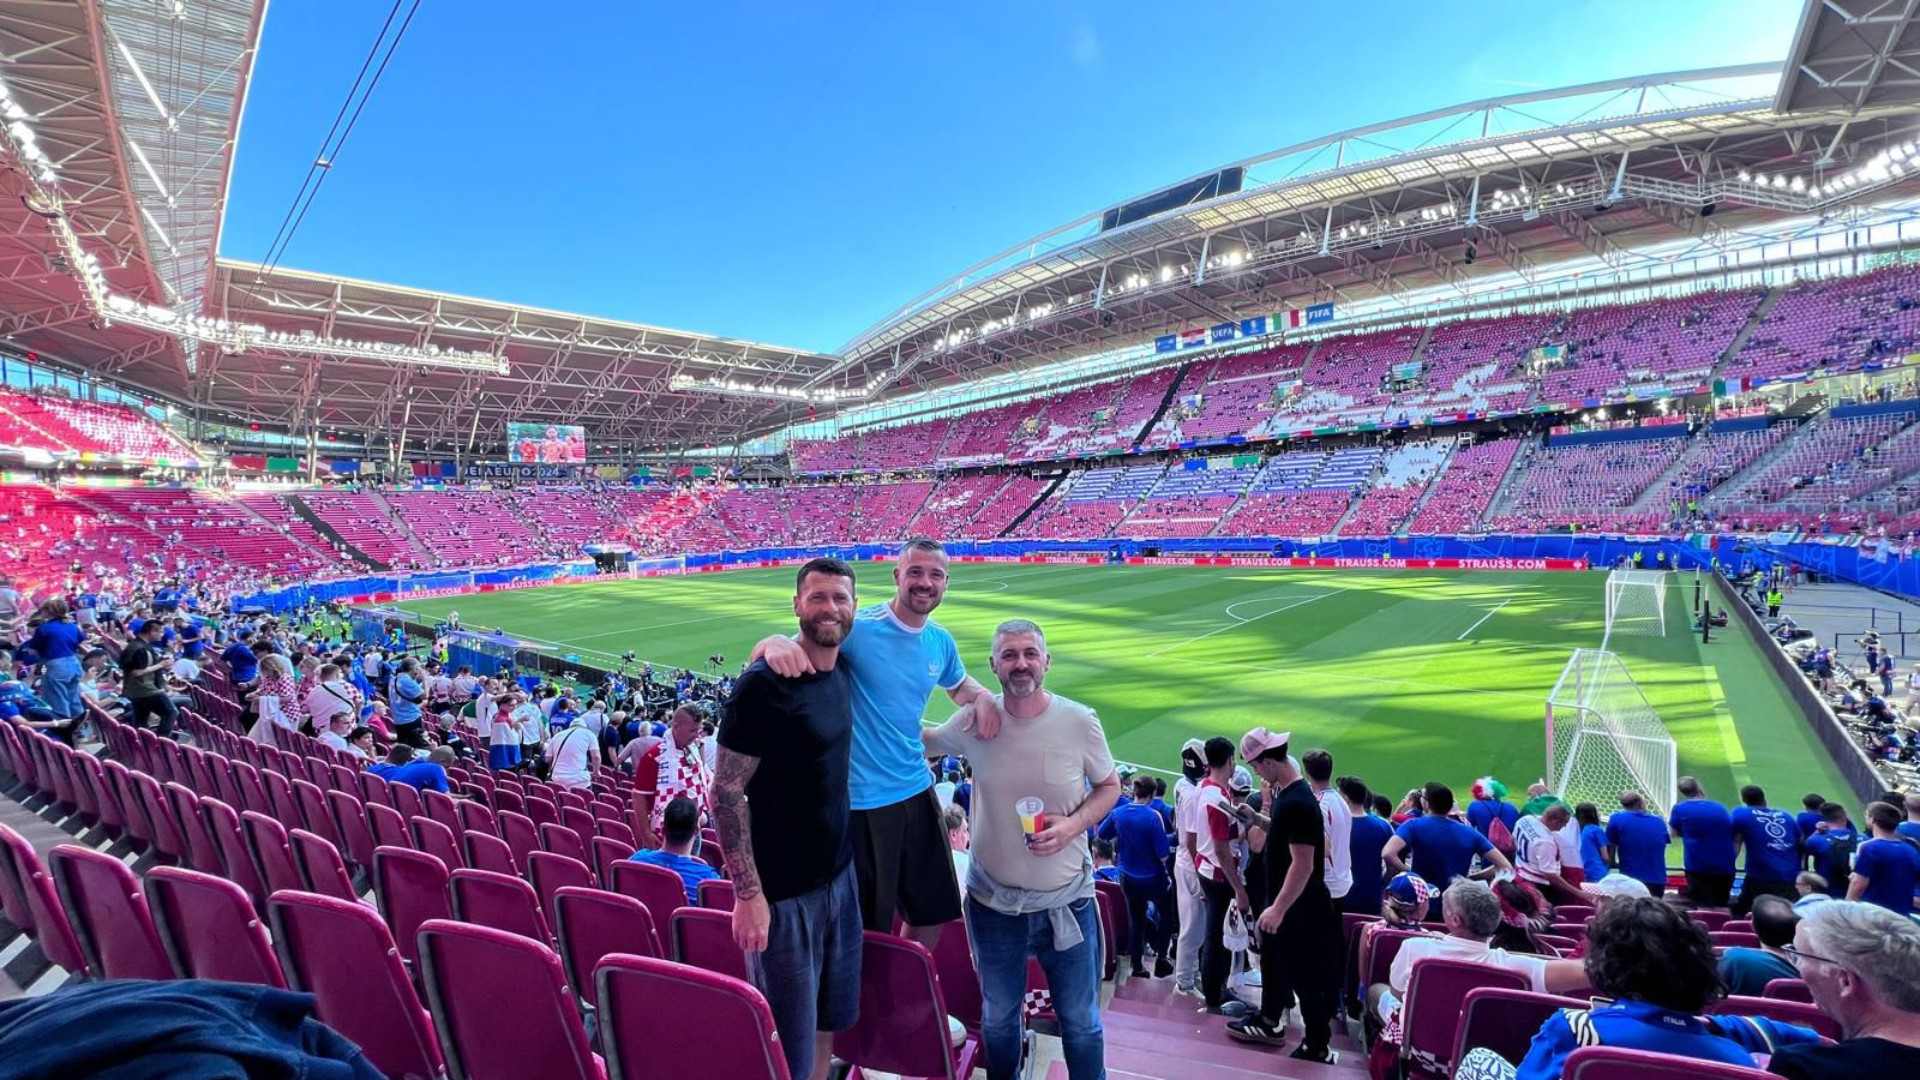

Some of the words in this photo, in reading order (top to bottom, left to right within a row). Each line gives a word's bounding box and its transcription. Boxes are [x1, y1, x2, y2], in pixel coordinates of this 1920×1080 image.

[1309, 308, 1330, 319] FIFA
[1212, 328, 1232, 337] UEFA
[1144, 557, 1194, 565] STRAUSS.COM
[1230, 558, 1291, 566] STRAUSS.COM
[1334, 559, 1406, 568] STRAUSS.COM
[1459, 559, 1546, 569] STRAUSS.COM
[494, 579, 553, 590] STRAUSS.COM
[391, 588, 461, 600] STRAUSS.COM
[1663, 1015, 1686, 1026] ITALIA
